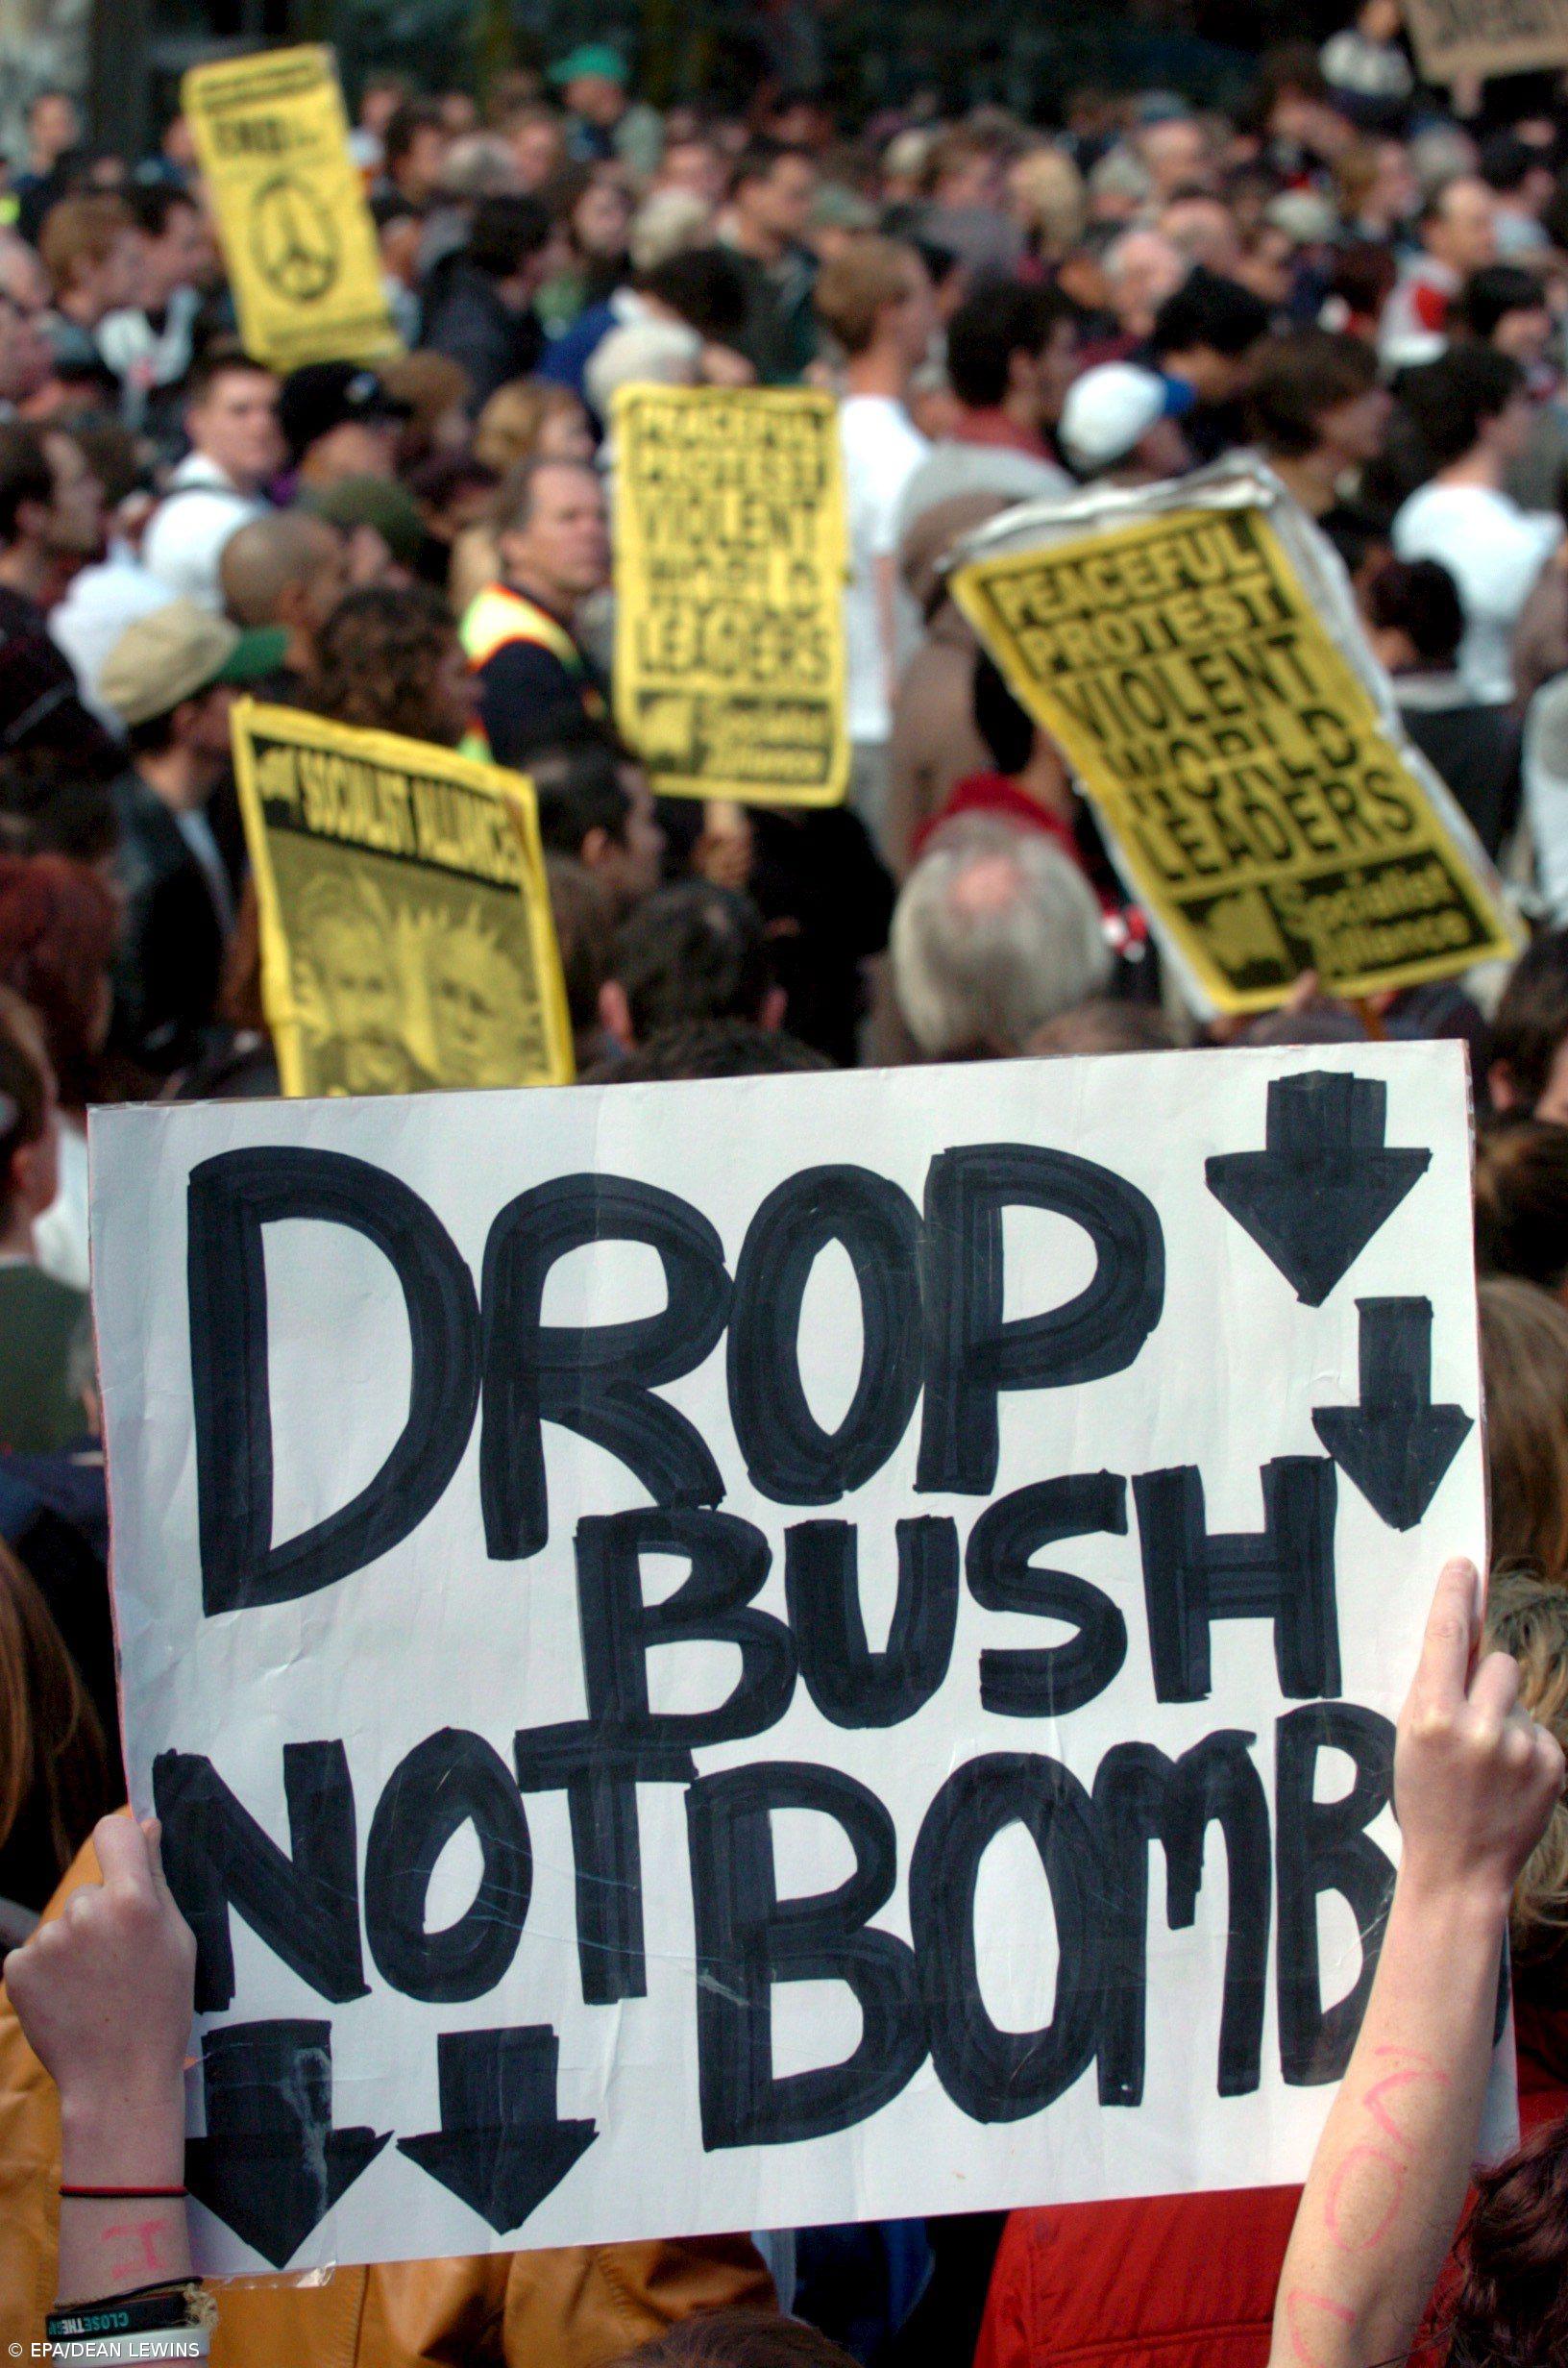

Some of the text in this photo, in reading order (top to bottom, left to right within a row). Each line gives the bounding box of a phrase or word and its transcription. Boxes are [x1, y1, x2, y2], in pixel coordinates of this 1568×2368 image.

[644, 494, 819, 552] VIOLENT
[987, 524, 1264, 625] PEACEFUL
[1015, 580, 1286, 671] PROTEST
[1052, 633, 1323, 745] VIOLENT
[1100, 706, 1361, 821] WORLD
[1129, 769, 1418, 882] LEADERS
[187, 1142, 1165, 1617] DROP
[574, 1455, 1342, 1747] BUSH
[153, 1702, 1509, 2153] NOT BOMB
